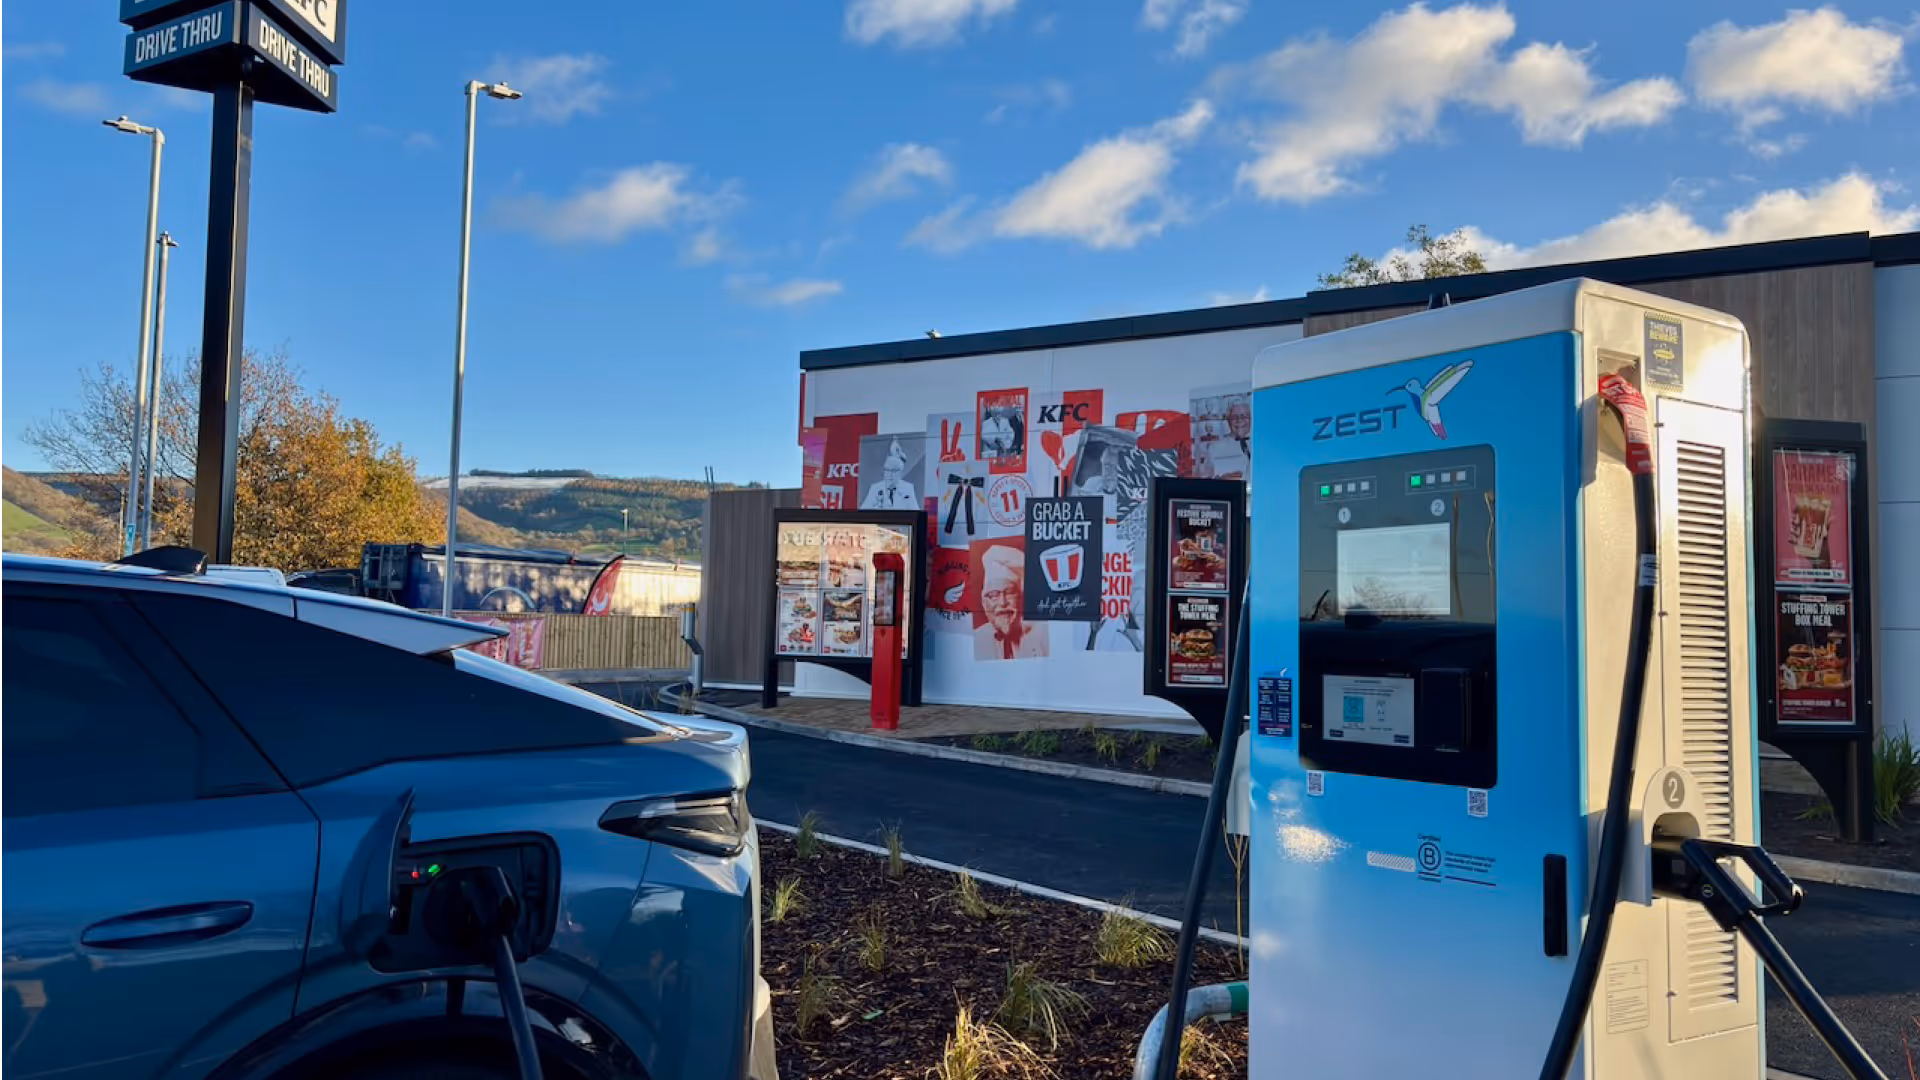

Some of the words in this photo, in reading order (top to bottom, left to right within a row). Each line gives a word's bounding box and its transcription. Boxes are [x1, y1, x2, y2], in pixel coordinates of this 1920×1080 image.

[135, 25, 179, 64] DRIVE
[181, 11, 223, 46] THRU
[259, 18, 297, 73] DRIVE
[299, 50, 330, 98] THRU
[1037, 403, 1089, 424] KFC
[1312, 404, 1407, 440] ZEST
[826, 463, 859, 479] KFC
[1001, 489, 1020, 513] 11
[1033, 502, 1070, 521] GRAB
[1074, 501, 1085, 520] A
[1032, 521, 1092, 541] BUCKET
[1177, 603, 1189, 612] THE
[1190, 604, 1219, 613] STUFFING
[1180, 611, 1199, 620] TOWER
[1201, 612, 1217, 620] MEAL
[1781, 602, 1819, 615] STUFFING
[1820, 603, 1846, 616] TOWER
[1795, 615, 1811, 626] BOX
[1812, 615, 1833, 626] MEAL
[1668, 778, 1679, 802] 2
[1424, 847, 1436, 865] B
